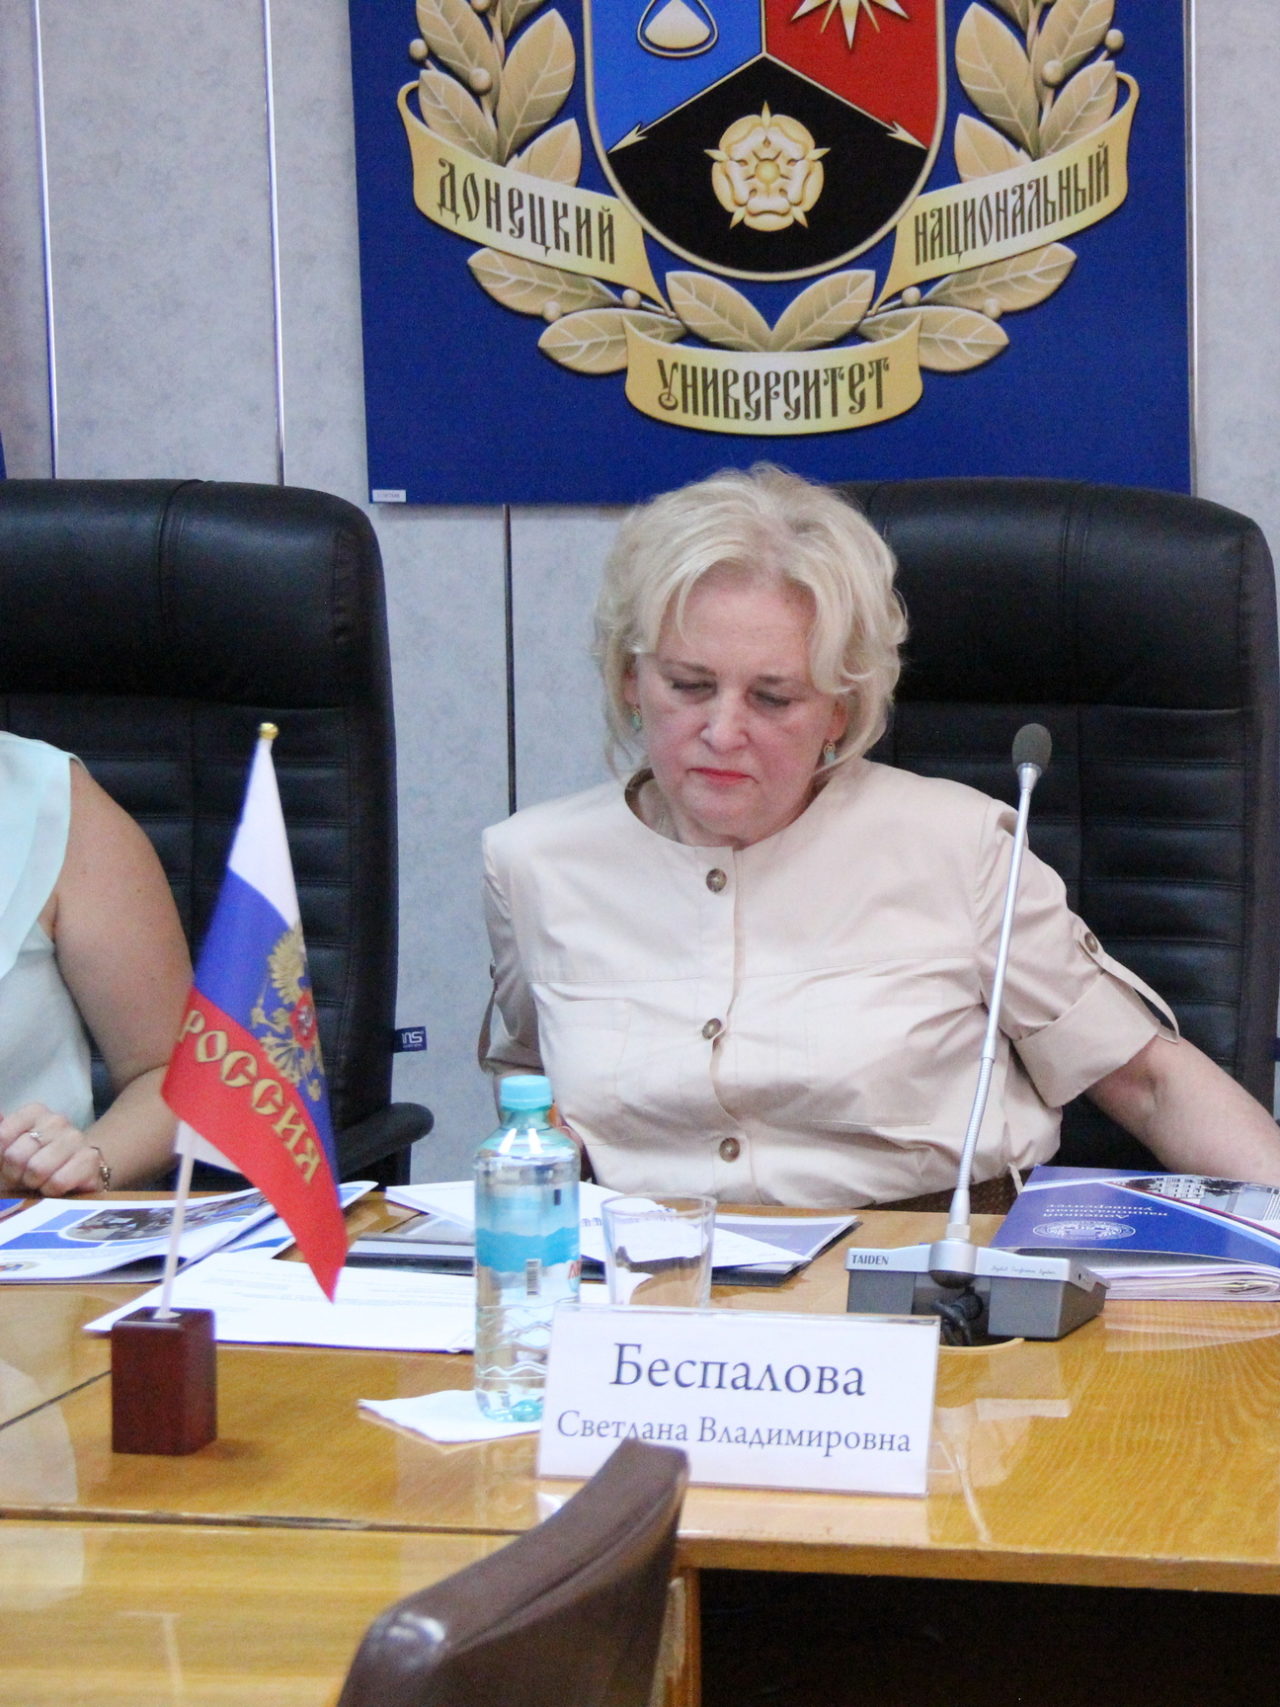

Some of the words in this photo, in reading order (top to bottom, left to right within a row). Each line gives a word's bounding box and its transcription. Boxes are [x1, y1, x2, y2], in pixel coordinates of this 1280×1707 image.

[438, 158, 615, 264] ДОНЕЦКИЙ
[915, 141, 1109, 265] НАЦИОНАЛЬНЫЙ
[657, 357, 889, 421] УНИВЕРСИТЕТ
[176, 1009, 321, 1184] РОССИЯ
[852, 1254, 890, 1265] TAIDEN
[609, 1342, 866, 1396] Беспалова
[557, 1409, 689, 1442] Светлана
[697, 1416, 911, 1457] Владимировна
